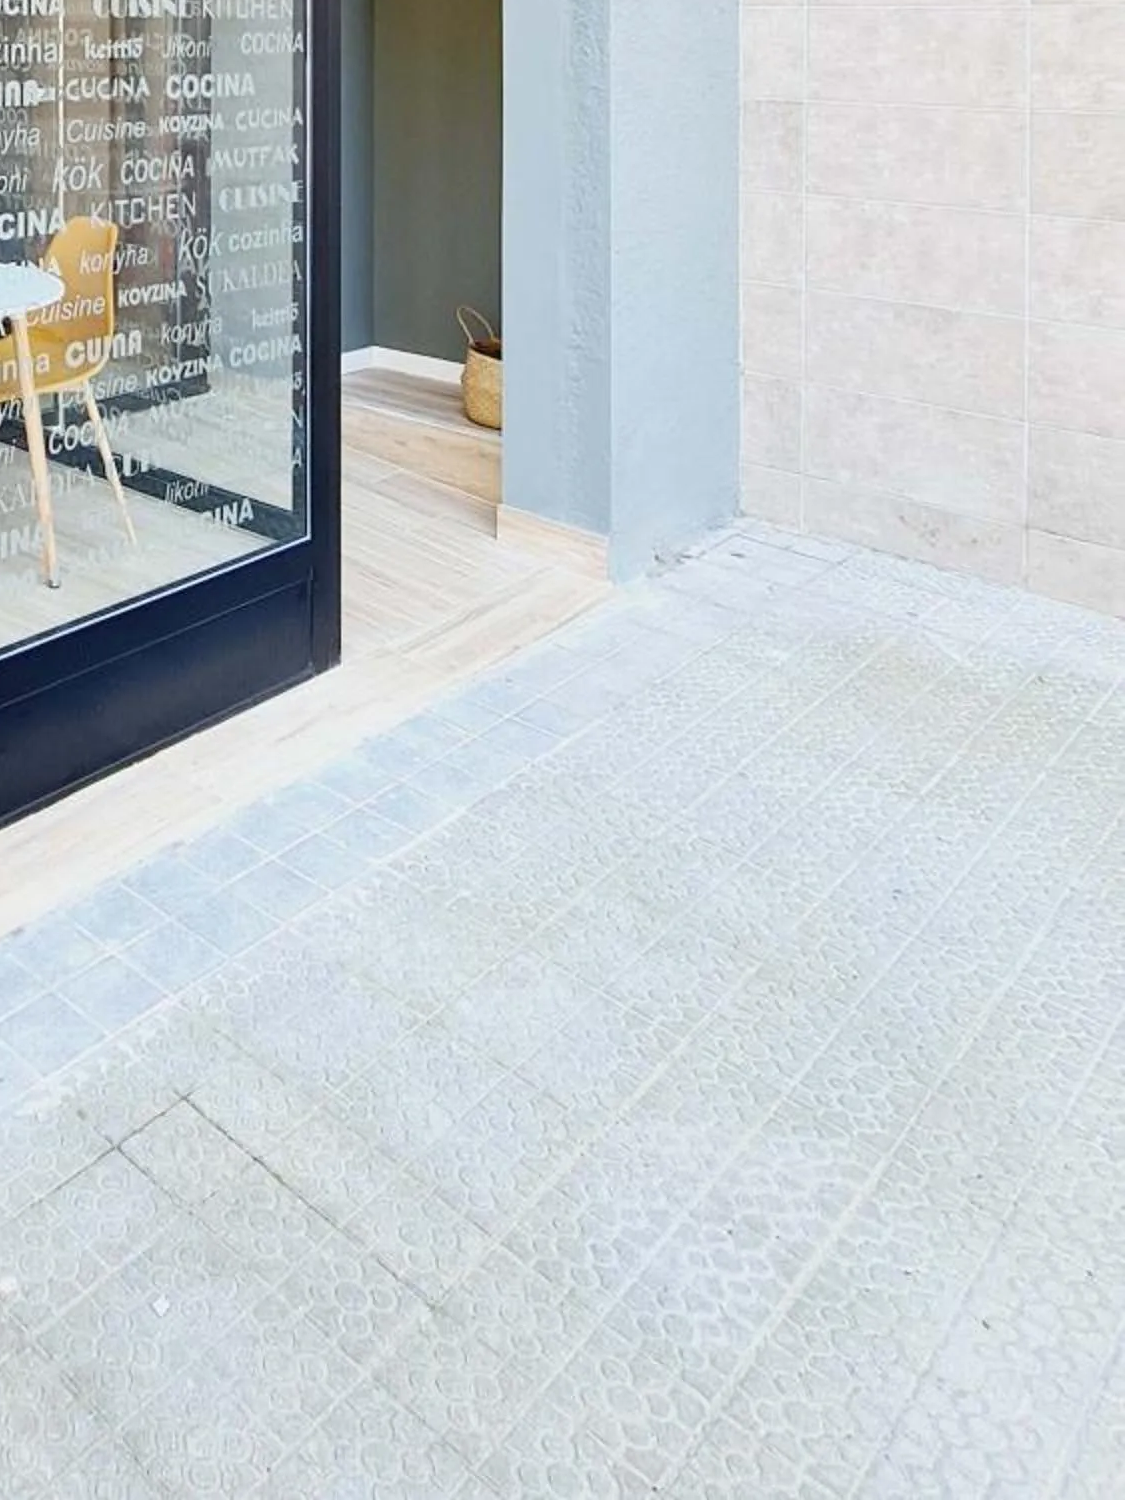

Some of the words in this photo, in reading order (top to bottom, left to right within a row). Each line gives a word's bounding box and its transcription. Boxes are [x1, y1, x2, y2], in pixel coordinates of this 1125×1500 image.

[65, 75, 152, 103] CUCINA
[165, 72, 256, 100] COCINA
[66, 118, 148, 146] Cuisine
[89, 192, 197, 231] KITCHEN
[229, 334, 304, 369] COCINA
